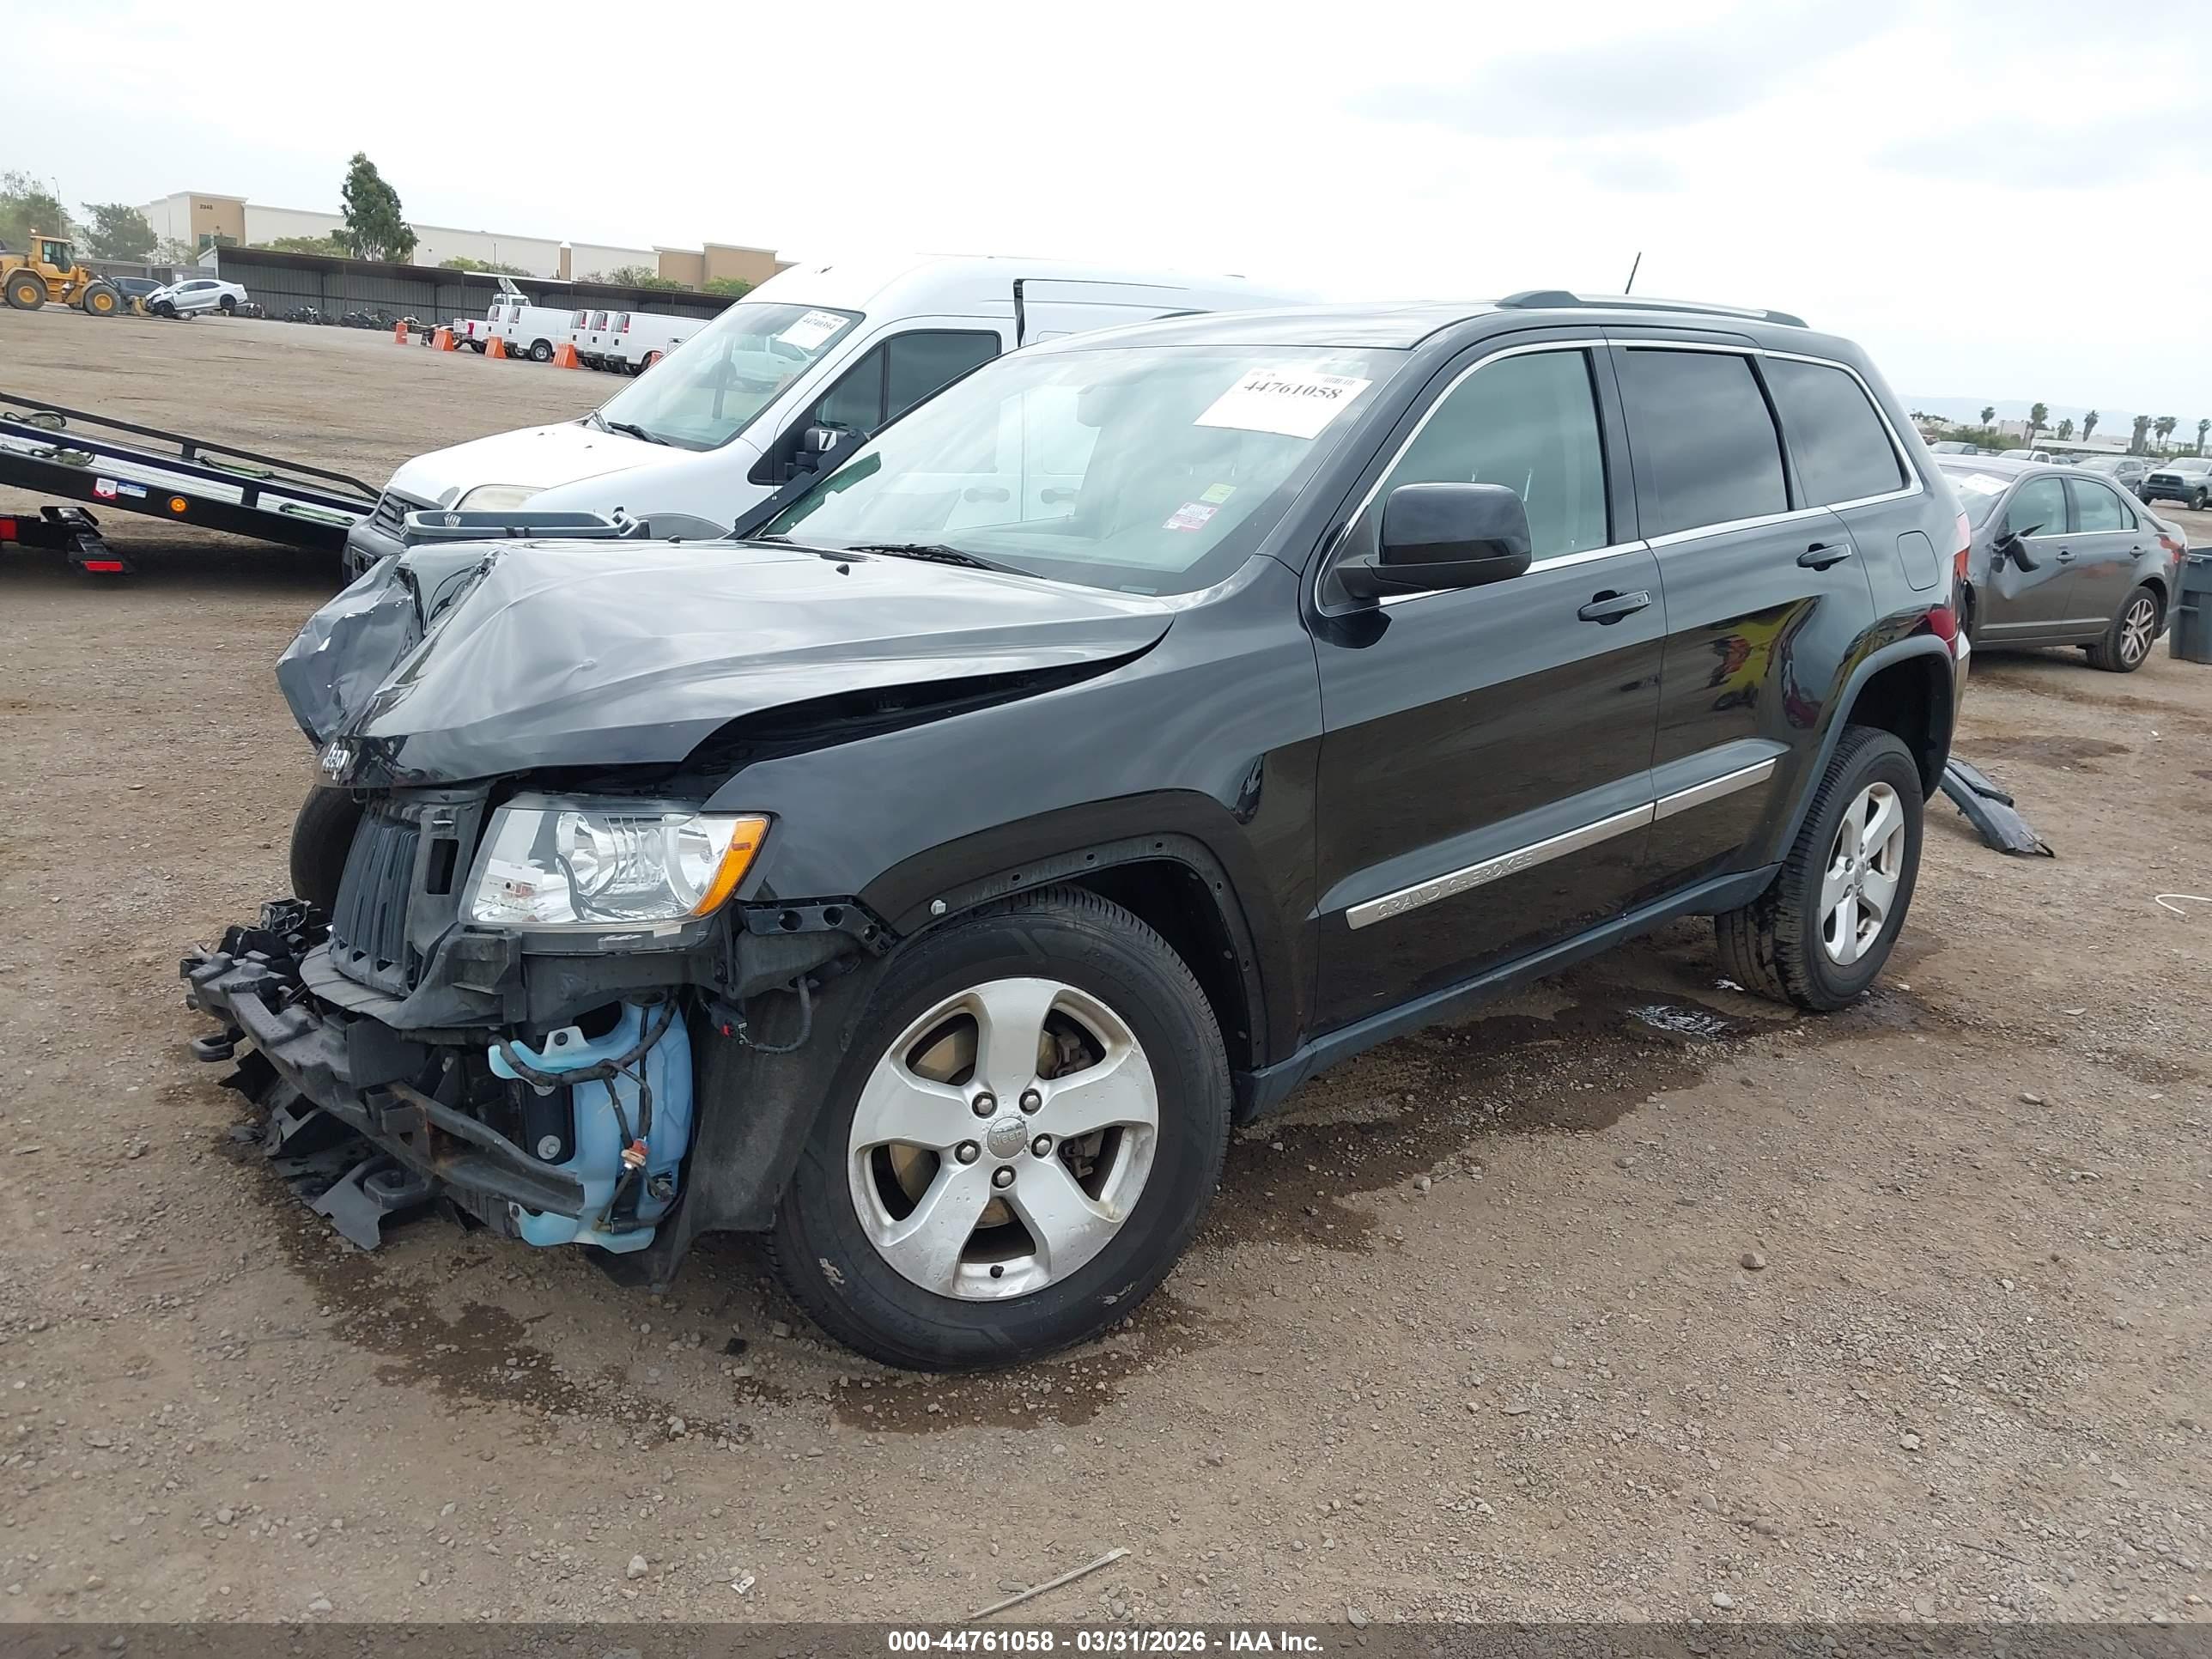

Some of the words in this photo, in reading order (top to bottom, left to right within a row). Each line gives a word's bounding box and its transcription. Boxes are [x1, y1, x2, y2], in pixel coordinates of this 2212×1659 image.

[1243, 380, 1343, 399] 44761058
[821, 430, 834, 450] 7
[1377, 884, 1442, 918] GRAND
[1449, 851, 1534, 893] CHEROKEE
[992, 1129, 1023, 1147] Jeep
